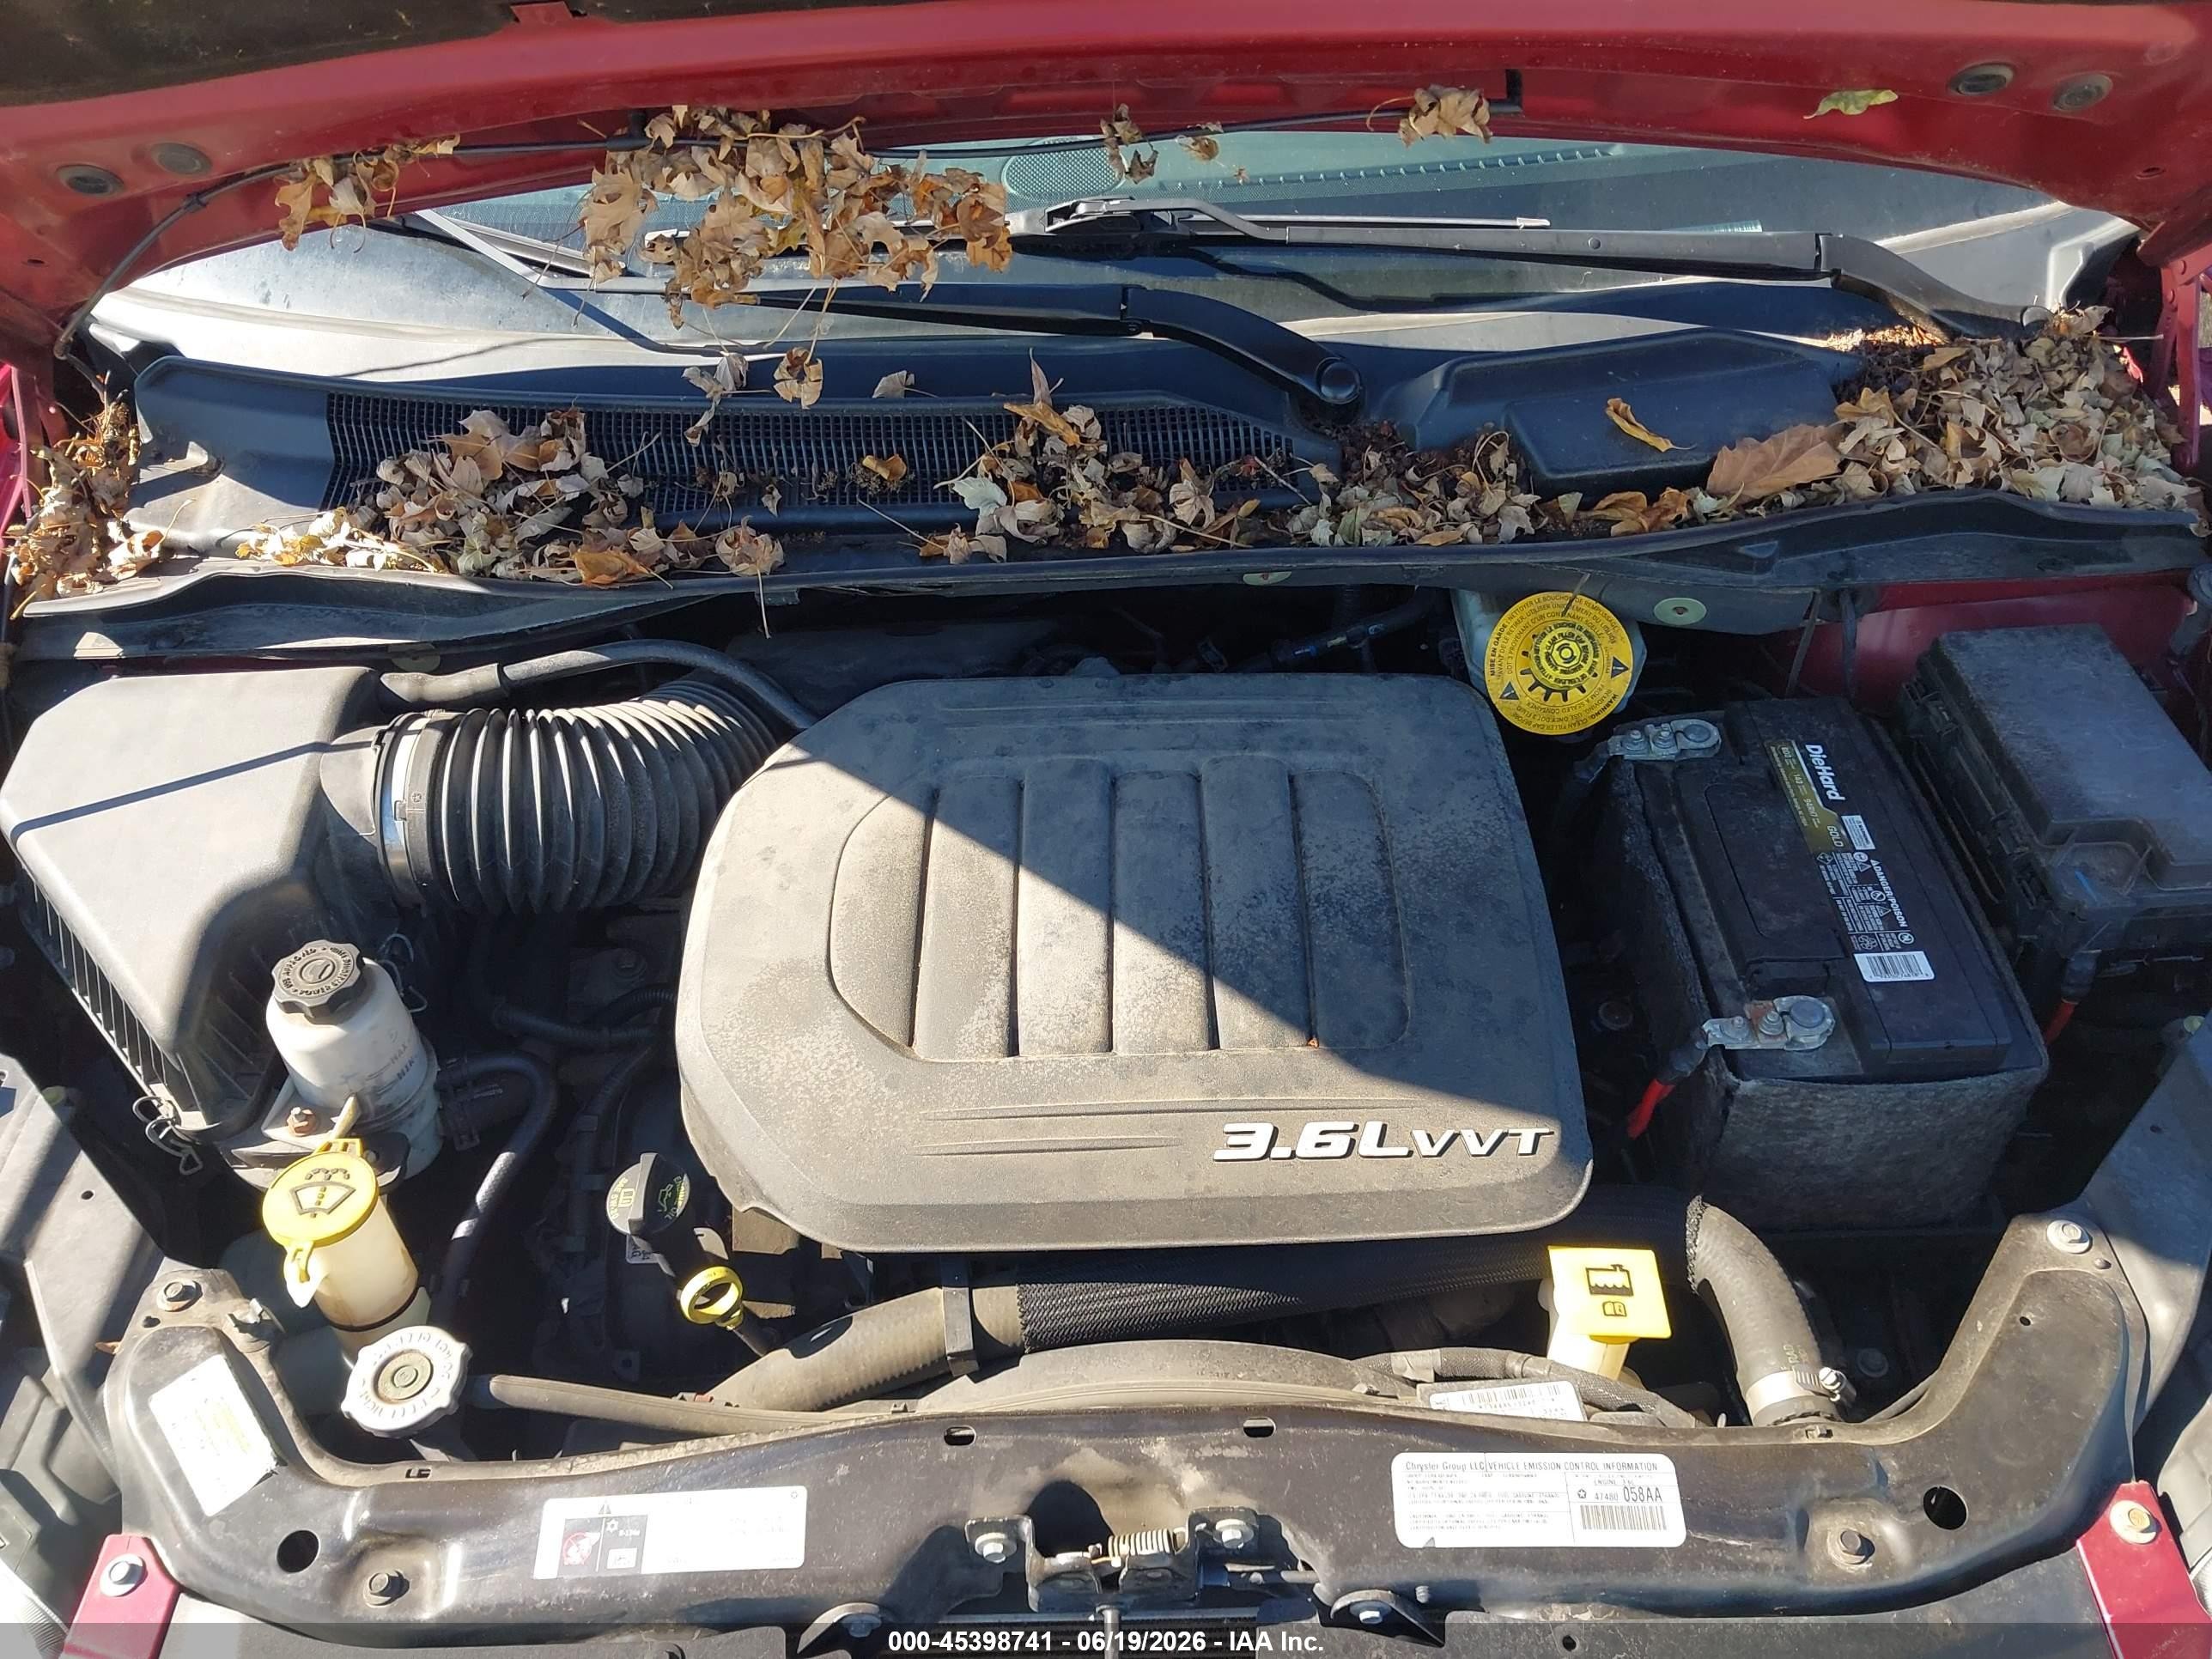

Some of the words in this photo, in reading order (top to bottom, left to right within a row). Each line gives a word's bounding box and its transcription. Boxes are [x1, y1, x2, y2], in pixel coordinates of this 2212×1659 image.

[1508, 601, 1534, 621] NETTOYER
[1493, 623, 1509, 647] GARDE
[1509, 620, 1530, 654] PROVENANT
[1490, 647, 1497, 658] EN
[1804, 744, 1846, 801] DieHard
[1826, 824, 1844, 848] GOLD
[1872, 866, 1908, 928] DANGER/POISON
[614, 1177, 629, 1194] SAE
[673, 1176, 685, 1206] ENGINE
[664, 1207, 678, 1220] OIL
[1406, 1461, 1439, 1473] Chrysler
[1442, 1461, 1467, 1473] Group
[1488, 1462, 1520, 1471] VEHICLE
[1523, 1462, 1561, 1471] EMISSION
[1564, 1462, 1600, 1471] CONTROL
[1603, 1462, 1658, 1471] INFORMATION
[1622, 1486, 1663, 1504] 058AA
